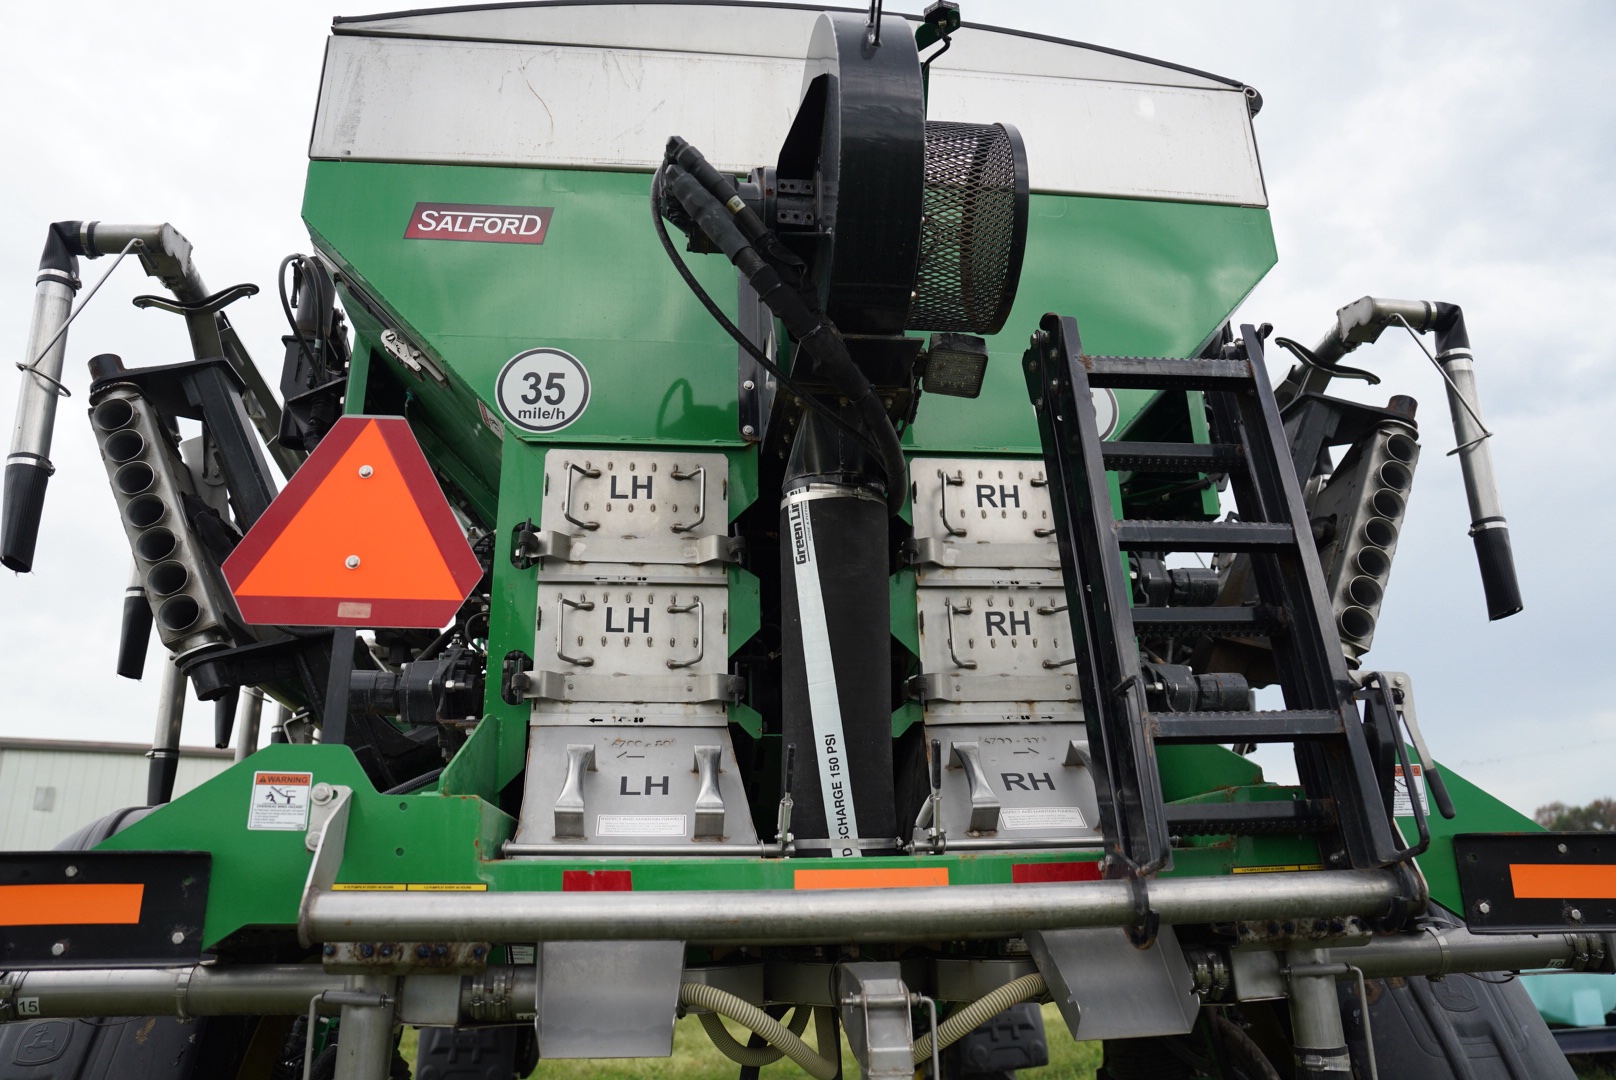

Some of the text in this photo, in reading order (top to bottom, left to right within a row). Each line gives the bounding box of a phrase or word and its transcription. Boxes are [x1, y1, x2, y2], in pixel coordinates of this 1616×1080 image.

[416, 210, 542, 236] SALFORD
[520, 371, 566, 406] 35
[517, 407, 566, 420] mile/h
[610, 475, 653, 500] LH
[975, 484, 1020, 508] RH
[795, 522, 806, 565] Green
[605, 606, 650, 634] LH
[985, 610, 1031, 636] RH
[824, 733, 838, 754] PSI
[828, 757, 841, 778] 150
[267, 775, 308, 784] WARNING
[619, 775, 670, 796] LH
[1000, 772, 1056, 791] RH
[19, 1000, 38, 1013] 15
